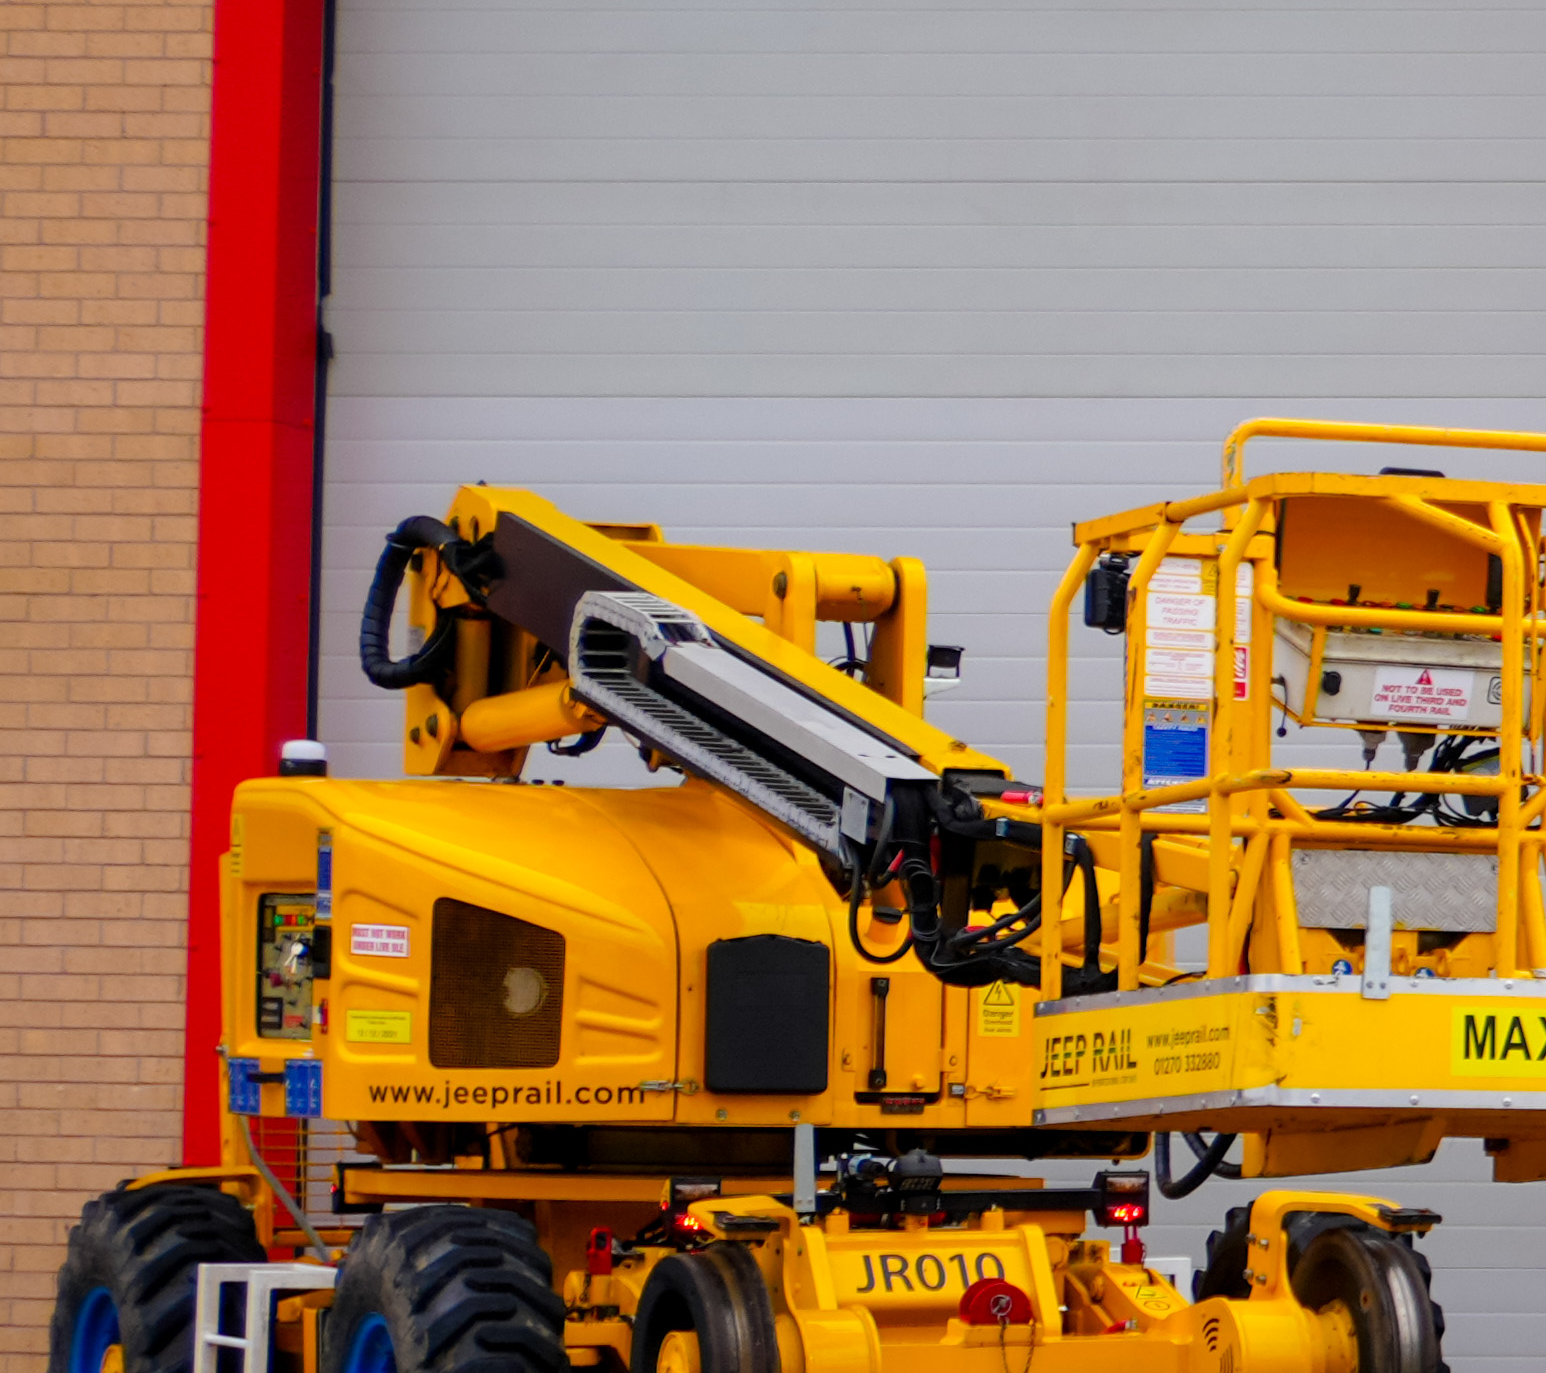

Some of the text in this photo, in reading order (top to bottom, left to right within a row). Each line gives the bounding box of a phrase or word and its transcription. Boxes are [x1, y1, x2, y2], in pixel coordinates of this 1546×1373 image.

[1374, 694, 1468, 707] ON LIVE THIRD AND
[1381, 684, 1463, 697] NOT TO BE USED
[1388, 704, 1452, 716] FOURTH RAIL
[1146, 1024, 1231, 1050] www.jeeprail.com
[1040, 1028, 1138, 1079] JEEP RAIL
[1153, 1055, 1181, 1076] 01270
[369, 1081, 645, 1109] www.jeeprail.com
[856, 1252, 1006, 1294] JR010
